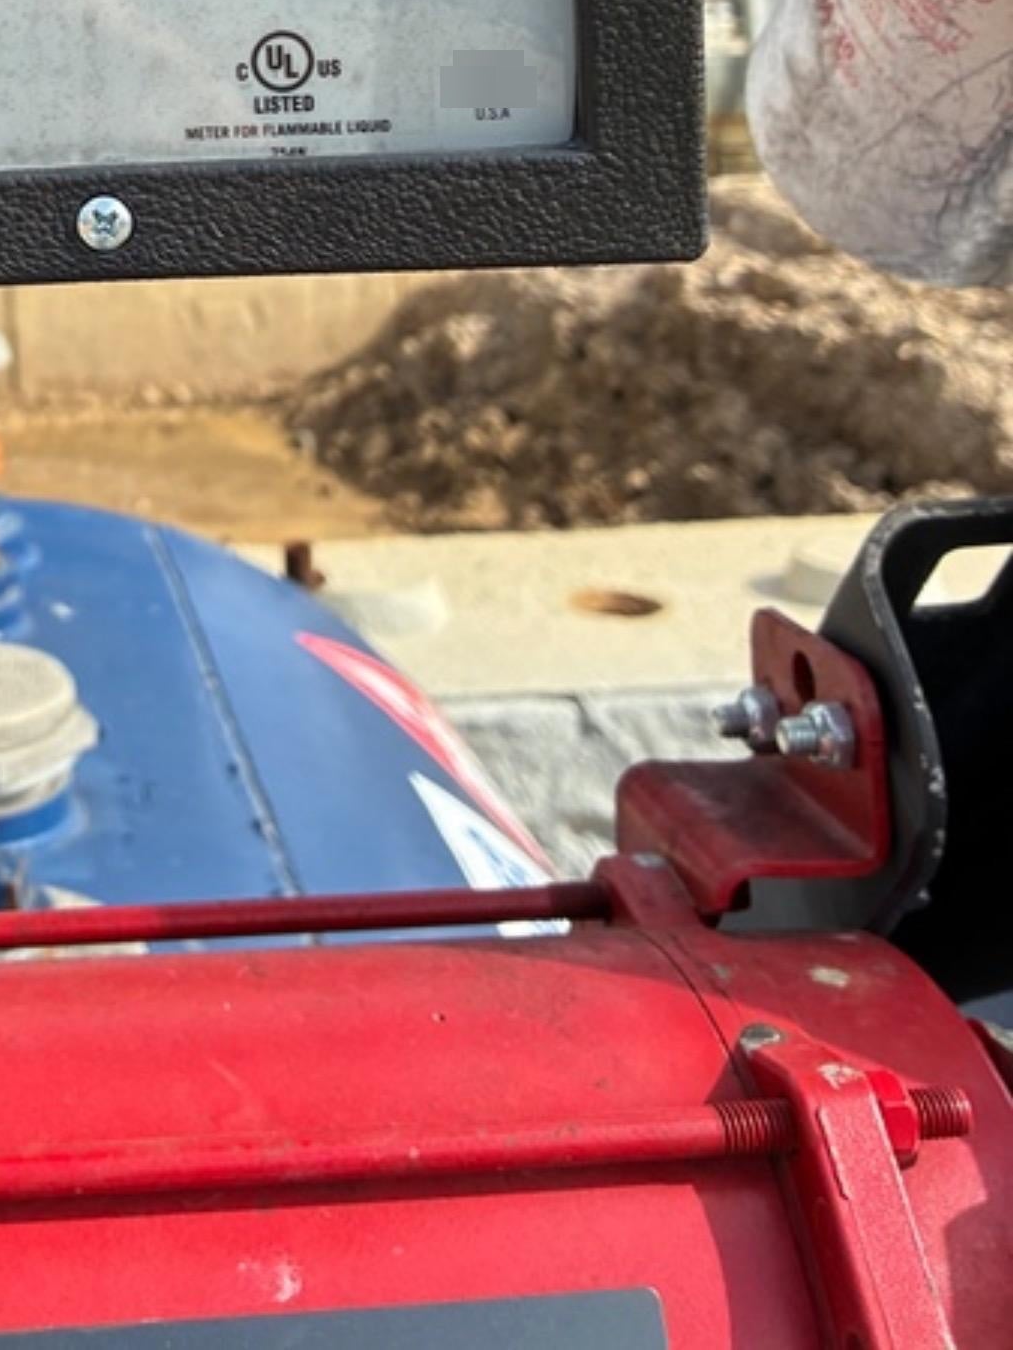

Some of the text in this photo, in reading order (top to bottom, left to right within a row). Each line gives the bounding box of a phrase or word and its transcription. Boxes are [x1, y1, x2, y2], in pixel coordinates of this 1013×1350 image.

[265, 44, 300, 79] UL
[316, 59, 343, 78] US
[253, 95, 316, 115] LISTED
[185, 118, 392, 140] METER FOR FLAMMABLE LIQUID
